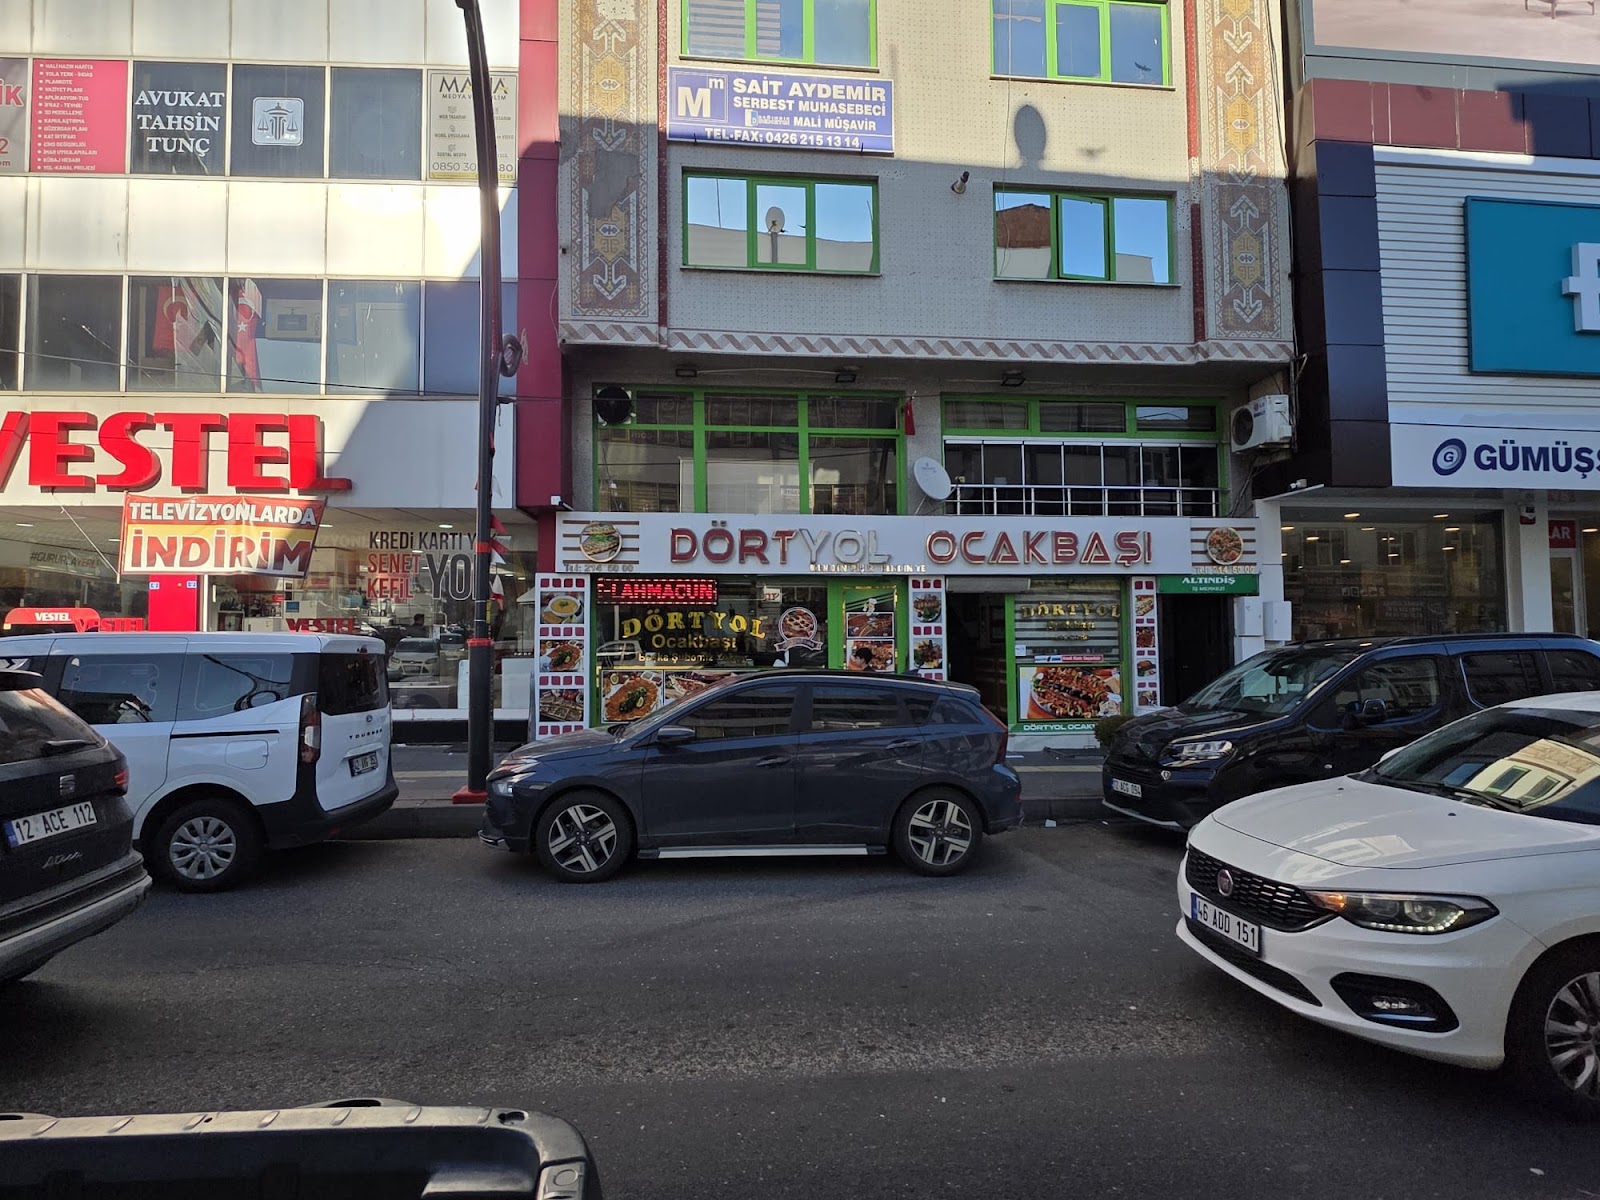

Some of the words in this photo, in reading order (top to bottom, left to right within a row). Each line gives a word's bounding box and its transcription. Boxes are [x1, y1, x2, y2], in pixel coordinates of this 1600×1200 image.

[134, 90, 225, 107] AVUKAT
[733, 76, 783, 96] SAİT
[789, 82, 886, 102] AYDEMİR
[733, 96, 794, 111] SERBEST
[799, 100, 886, 117] MUHASEBECİ
[136, 112, 220, 131] TAHSİN
[793, 114, 822, 129] MALİ
[824, 116, 877, 131] MÜŞAVİR
[146, 137, 210, 157] TUNÇ
[705, 128, 763, 142] TEL-FAX:
[765, 132, 798, 145] 0426
[800, 134, 826, 146] 215
[827, 136, 842, 147] 13
[844, 137, 860, 147] 14
[432, 162, 460, 171] 0850
[1474, 439, 1600, 479] GÜMÜŞ
[129, 500, 317, 526] TELEVİZYONLARDA
[130, 527, 312, 573] İNDİRİM
[418, 532, 463, 551] KARTI
[669, 520, 892, 565] DÖRTYOL
[925, 530, 1153, 567] OCAKBAŞI
[367, 553, 422, 575] SENET
[426, 553, 477, 600] YO
[1182, 575, 1236, 585] ALTINDİŞ
[35, 612, 72, 622] VESTEL
[1021, 601, 1120, 618] DÖRTYOL
[621, 608, 766, 639] DÖRTYOL
[1023, 722, 1067, 731] DÖRTYOL
[16, 819, 35, 841] 12
[42, 810, 69, 833] ACE
[73, 804, 95, 825] 112
[1212, 908, 1230, 934] ADD
[1236, 920, 1255, 948] 151
